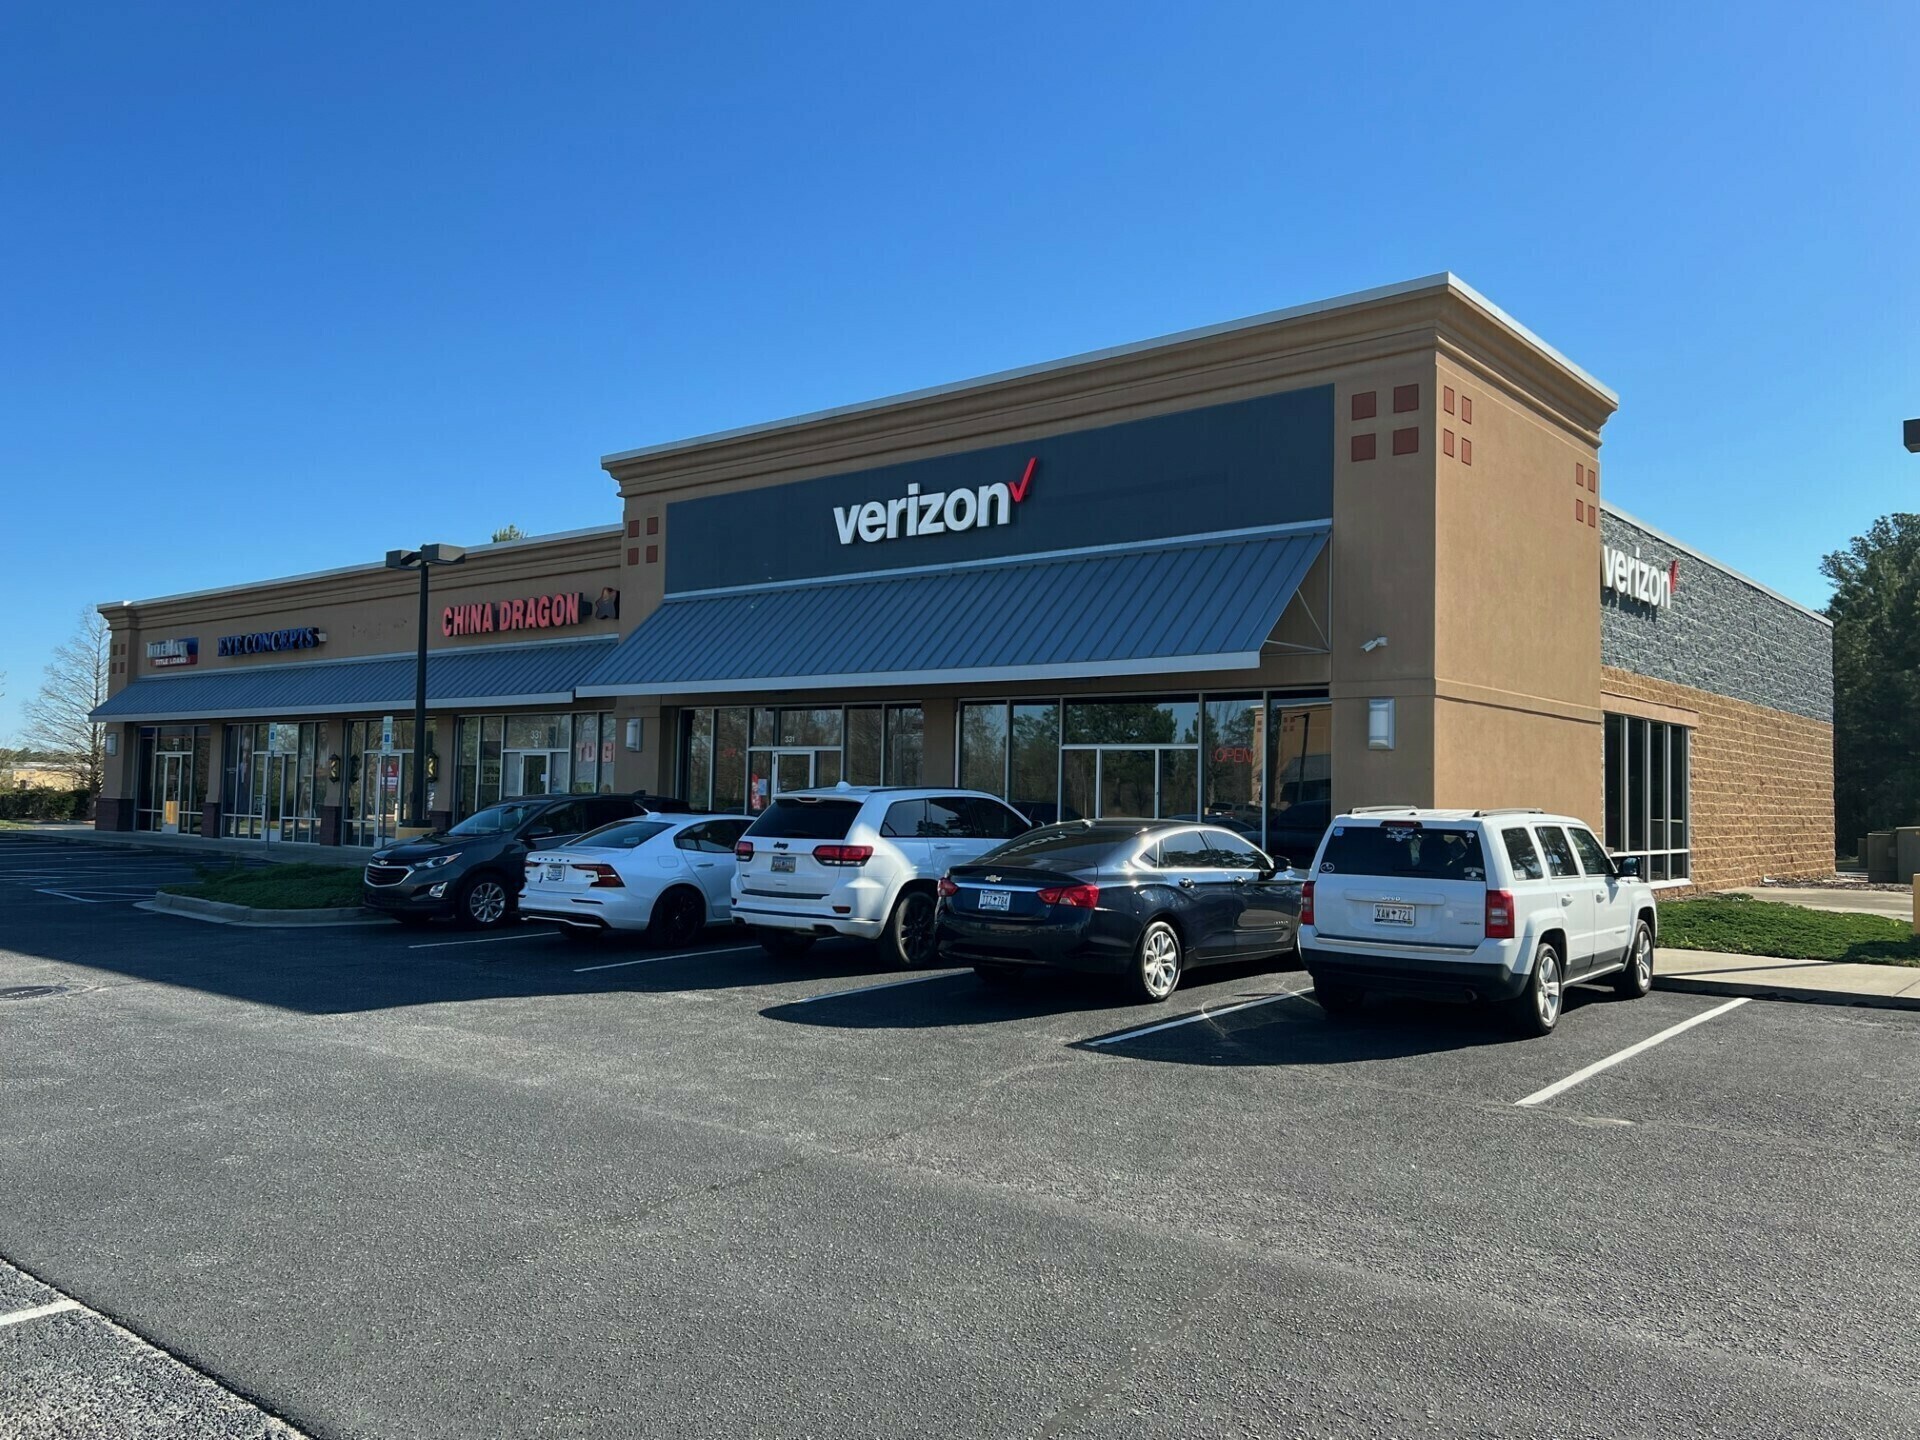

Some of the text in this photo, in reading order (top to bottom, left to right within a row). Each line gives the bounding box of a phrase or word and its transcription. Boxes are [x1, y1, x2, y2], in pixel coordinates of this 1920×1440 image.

[833, 482, 1011, 545] verizon
[1602, 544, 1671, 609] verizon
[442, 592, 579, 637] CHINA DRAGON
[217, 627, 315, 657] EYE CONCEPTS
[155, 658, 168, 666] TITLE
[530, 730, 542, 740] 331
[784, 735, 795, 743] 331
[602, 742, 616, 763] G
[1214, 747, 1252, 763] OPEN
